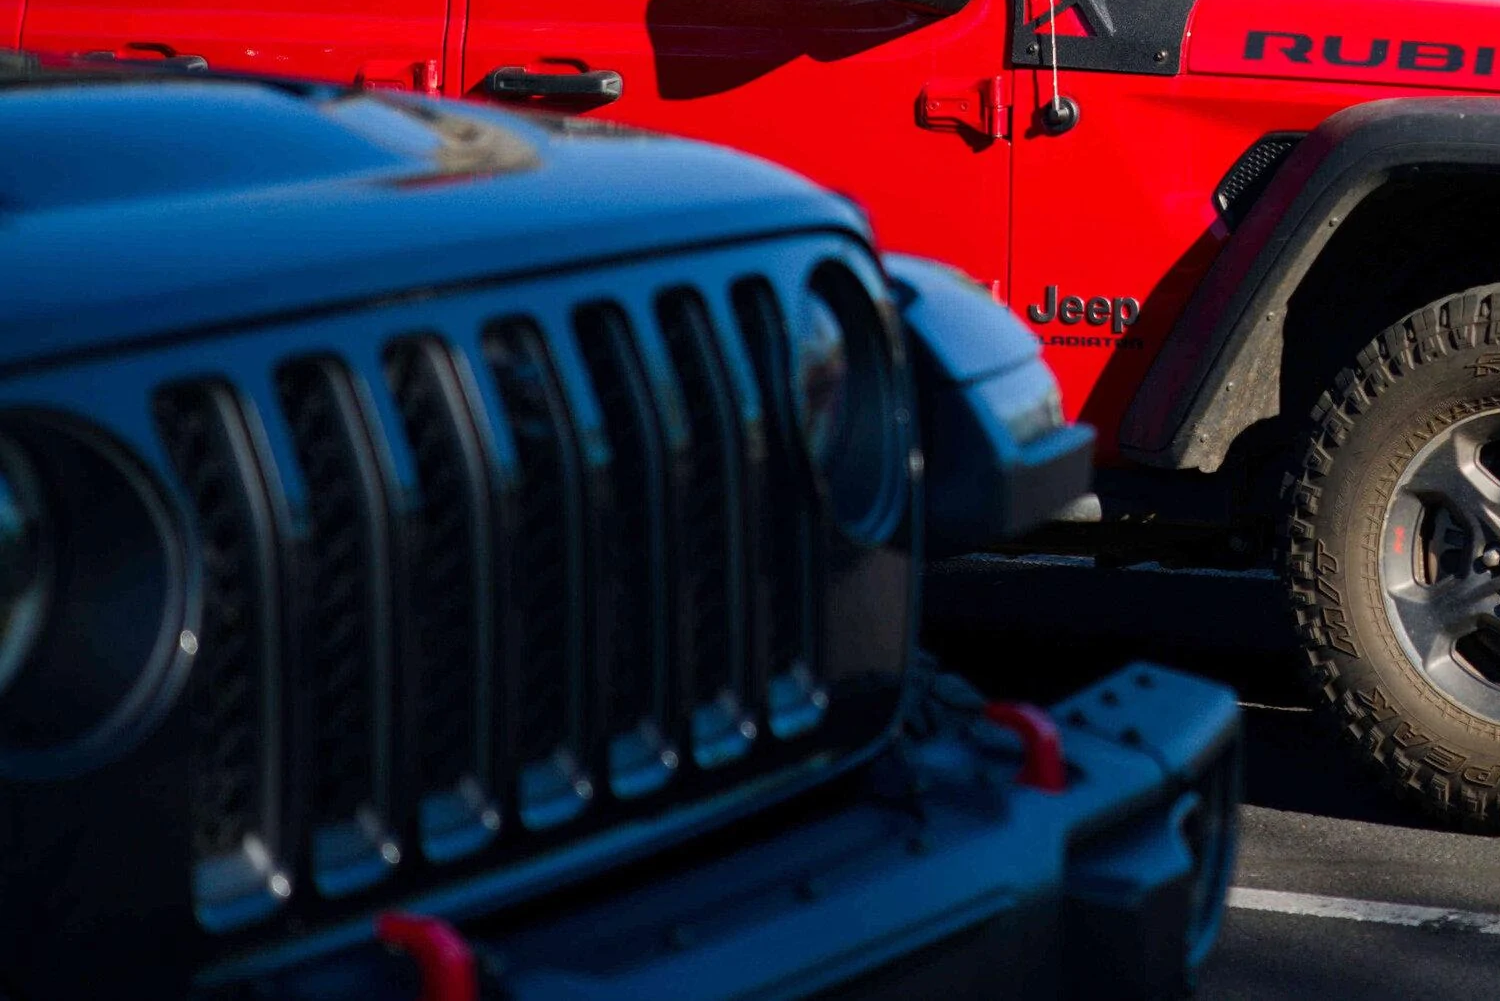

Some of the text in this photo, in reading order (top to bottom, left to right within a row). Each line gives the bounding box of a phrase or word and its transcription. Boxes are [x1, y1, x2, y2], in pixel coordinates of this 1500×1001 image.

[1028, 285, 1140, 334] Jeep
[1038, 336, 1144, 349] LADIAT
[1316, 538, 1360, 659] M/T
